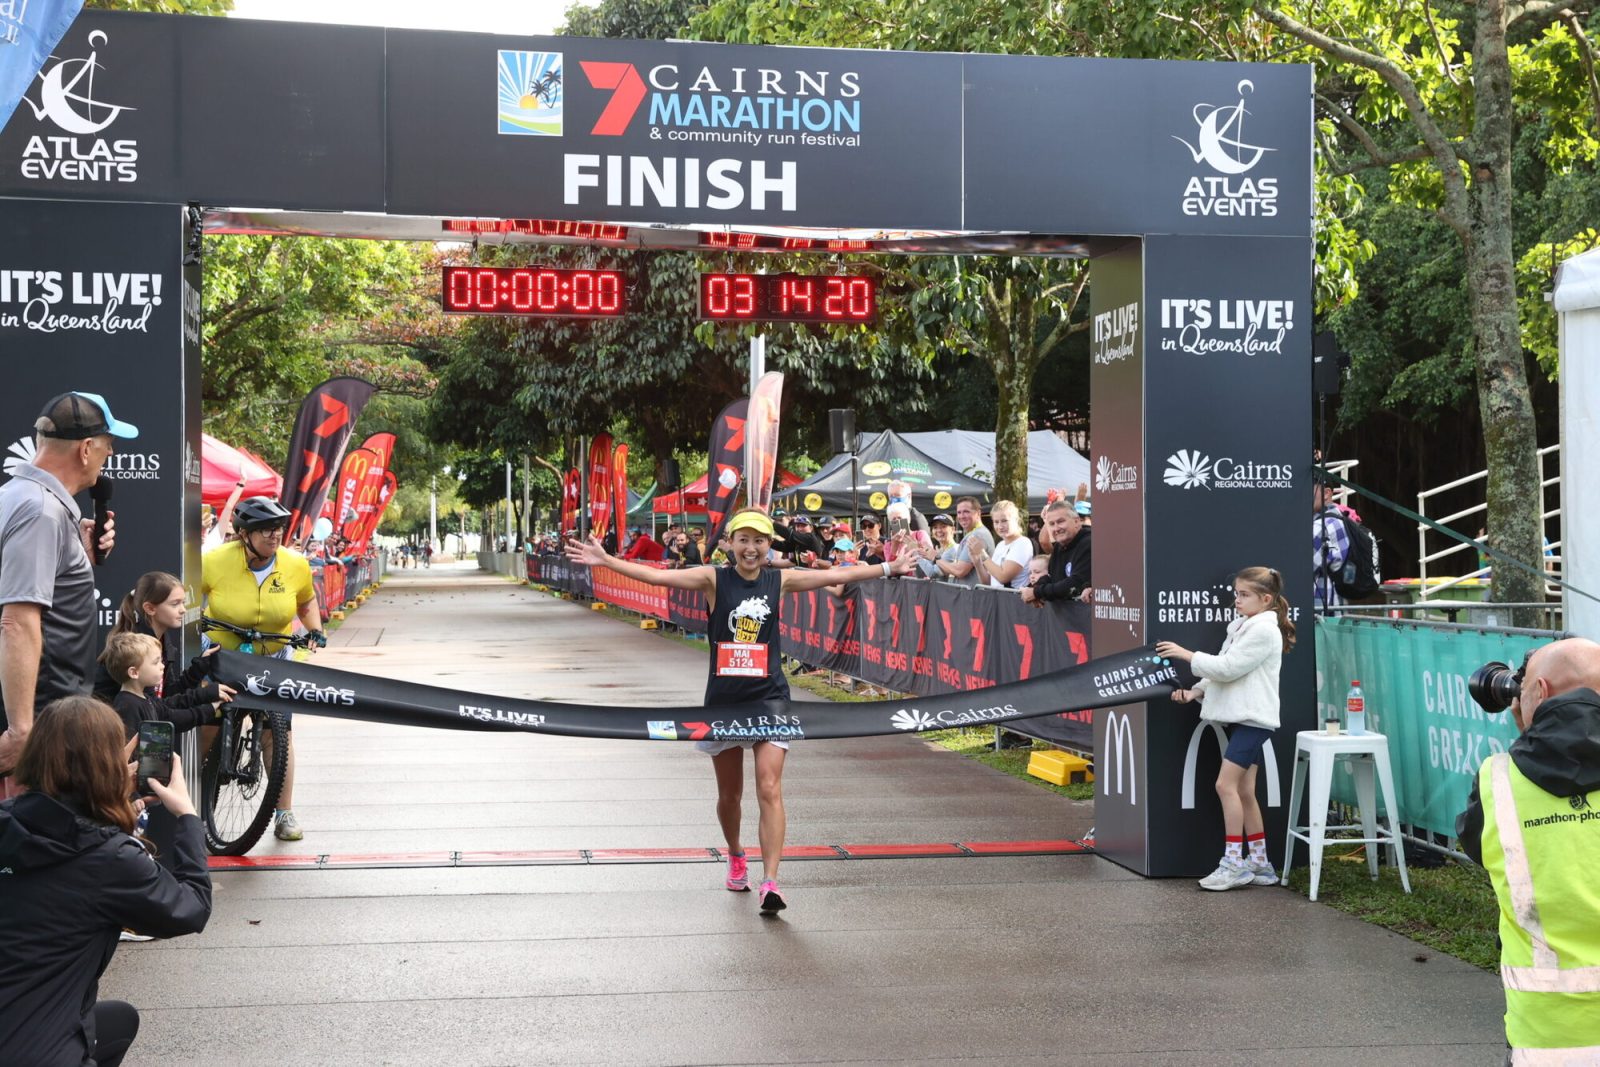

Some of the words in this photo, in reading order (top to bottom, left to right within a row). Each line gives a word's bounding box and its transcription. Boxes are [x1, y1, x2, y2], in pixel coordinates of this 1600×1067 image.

[649, 64, 861, 97] CAIRNS
[649, 93, 861, 132] MARATHON
[650, 127, 662, 140] &
[668, 129, 762, 146] community
[768, 133, 795, 145] run
[801, 132, 861, 147] festival
[22, 136, 138, 162] ATLAS
[21, 159, 138, 182] EVENTS
[564, 153, 797, 211] FINISH
[1183, 177, 1278, 198] ATLAS
[1182, 198, 1278, 217] EVENTS
[1, 270, 63, 304] IT'S
[72, 272, 162, 306] LIVE!
[451, 270, 618, 310] 00:00:00
[1, 312, 19, 327] in
[23, 297, 152, 334] Queensland
[1095, 311, 1111, 343] IT'S
[1113, 302, 1138, 337] LIVE!
[1161, 299, 1212, 329] IT'S
[1219, 299, 1294, 330] LIVE!
[1101, 328, 1136, 365] Queensland
[1161, 337, 1176, 351] in
[1179, 322, 1286, 356] Queensland
[101, 453, 160, 471] irns
[1111, 461, 1137, 483] Cairns
[1213, 457, 1293, 480] Cairns
[116, 470, 160, 480] COUNCIL
[1215, 480, 1255, 488] REGIONAL
[1256, 480, 1293, 488] COUNCIL
[1095, 588, 1111, 603] CAIRNS
[1158, 590, 1210, 605] CAIRNS
[1212, 595, 1220, 605] &
[1095, 605, 1108, 619] GREAT
[1158, 608, 1201, 622] GREAT
[1205, 607, 1240, 622] BARR
[729, 658, 754, 667] 5124
[733, 649, 750, 658] MAI
[279, 678, 356, 696] ATLAS
[1094, 666, 1136, 688] CAIRNS
[1137, 667, 1144, 675] &
[1098, 681, 1133, 697] GREAT
[1134, 666, 1178, 690] BARRIE
[277, 686, 356, 706] EVENTS
[459, 704, 492, 718] IT'S
[496, 709, 546, 724] LIVE!
[711, 714, 801, 729] CAIRNS
[937, 704, 1018, 723] Cairns
[713, 725, 804, 737] MARATHON
